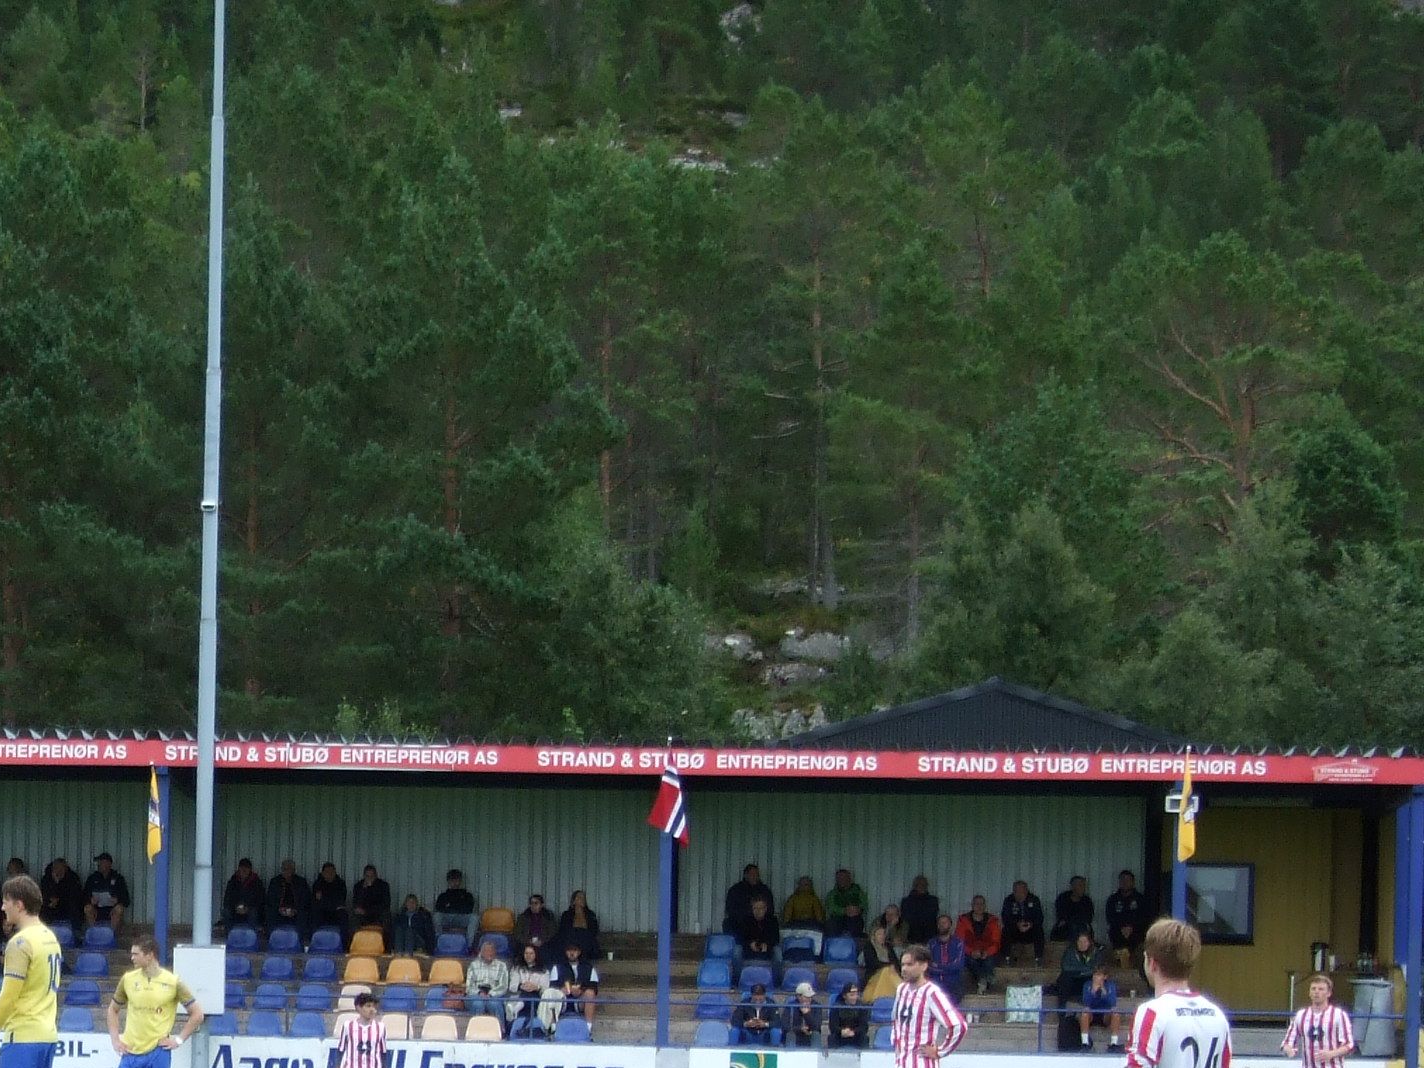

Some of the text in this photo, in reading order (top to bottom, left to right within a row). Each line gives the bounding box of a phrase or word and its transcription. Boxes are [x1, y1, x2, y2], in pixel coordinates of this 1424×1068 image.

[102, 745, 127, 760] AS
[165, 745, 498, 765] STRND & STUBØ ENTREPRENØR AS
[538, 751, 615, 767] STRAND
[621, 753, 633, 768] &
[717, 754, 848, 771] ENTREPRENØR
[853, 756, 877, 771] AS
[918, 756, 1266, 776] STRAND & STUBØ ENTREPRENØR AS
